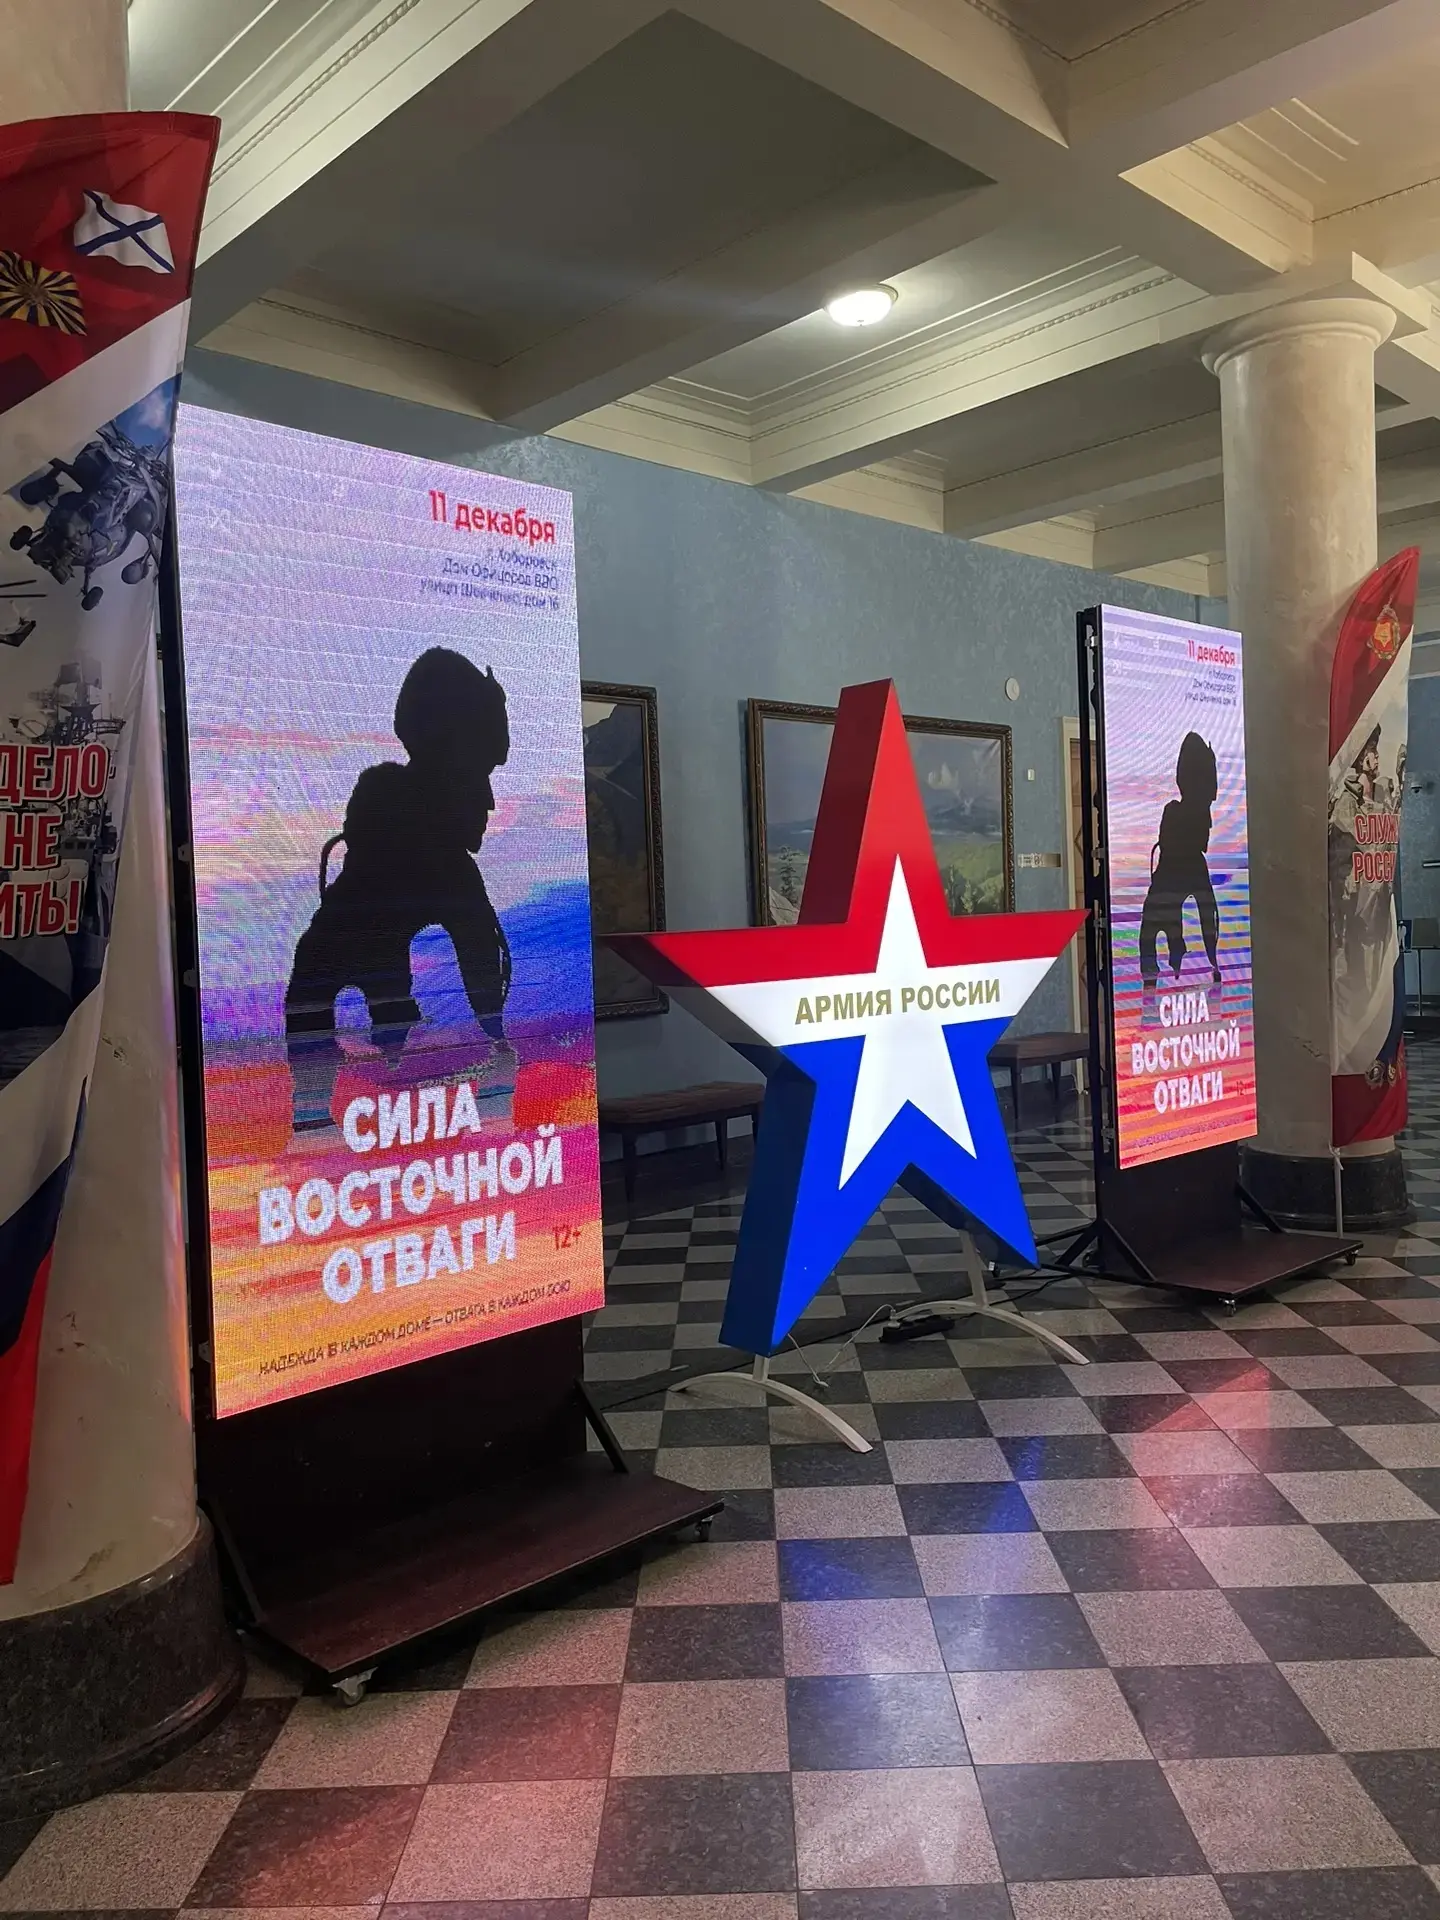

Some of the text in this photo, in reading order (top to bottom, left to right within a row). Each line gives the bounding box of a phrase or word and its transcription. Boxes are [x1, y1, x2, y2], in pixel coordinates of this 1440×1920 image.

[428, 490, 556, 547] 11 декабря
[1197, 645, 1235, 667] декабря
[3, 811, 63, 871] НЕ
[795, 978, 1000, 1025] АРМИЯ РОССИИ
[1159, 991, 1210, 1028] СИЛА
[1131, 1019, 1240, 1076] ВОСТОЧНОЙ
[343, 1083, 482, 1153] СИЛА
[1153, 1070, 1224, 1114] ОТВАГИ
[258, 1124, 564, 1245] ВОСТОЧНОЙ
[322, 1211, 517, 1304] ОТВАГИ
[552, 1224, 582, 1250] 12+
[258, 1346, 325, 1376] НАДЕЖДА
[327, 1341, 338, 1358] В
